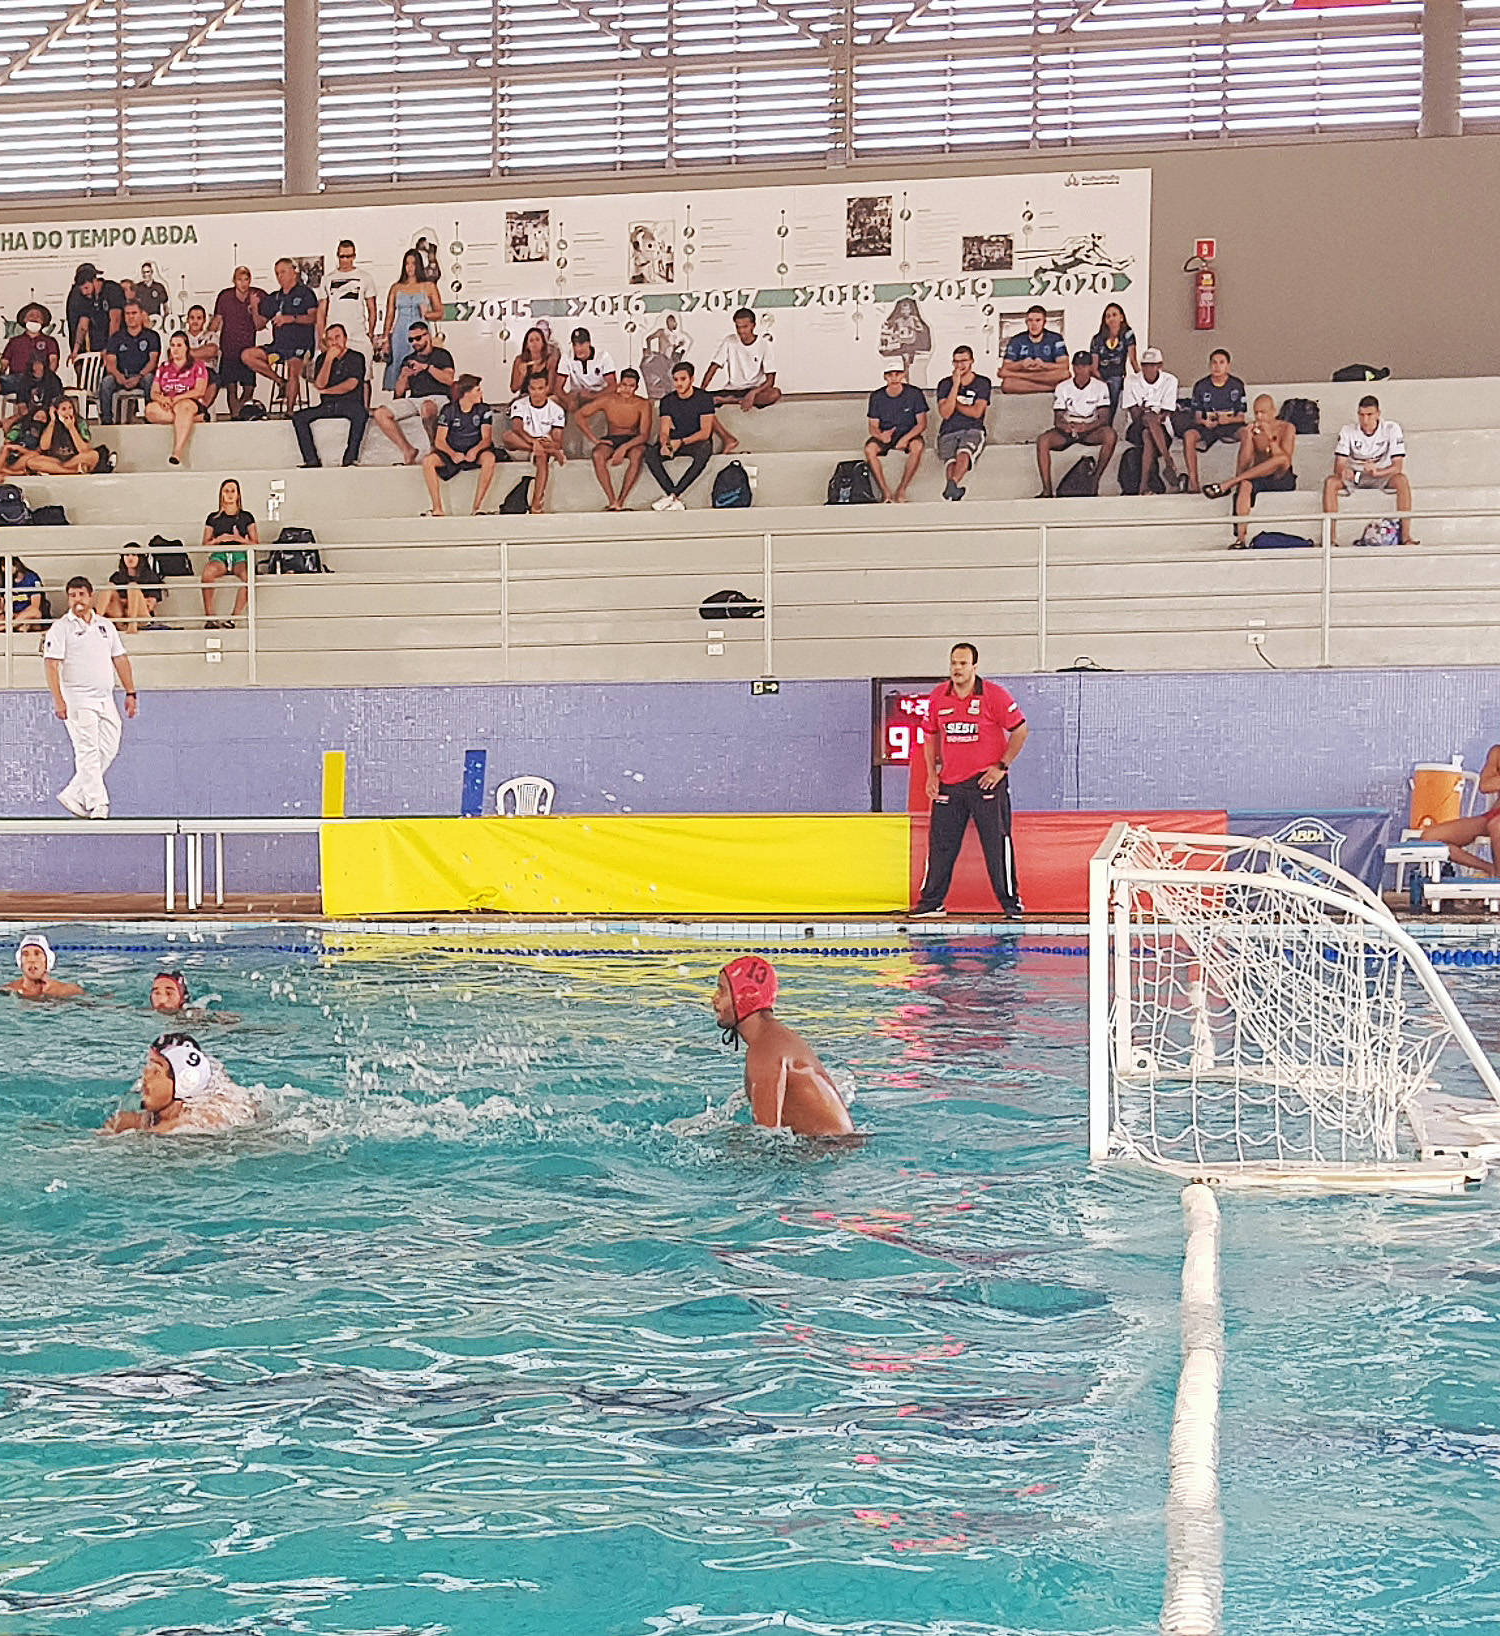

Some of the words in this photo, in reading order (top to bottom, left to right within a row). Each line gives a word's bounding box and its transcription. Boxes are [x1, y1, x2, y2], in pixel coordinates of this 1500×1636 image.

[32, 229, 63, 250] DO
[67, 226, 137, 249] TEMPO
[140, 224, 199, 246] ABDA
[806, 280, 876, 306] 2018
[925, 276, 994, 301] 2019
[1043, 272, 1116, 297] 2020
[469, 300, 533, 322] 2015
[580, 291, 646, 317] 2016
[691, 287, 759, 311] 2017
[1287, 830, 1325, 842] ABDA
[186, 1052, 201, 1067] 9
